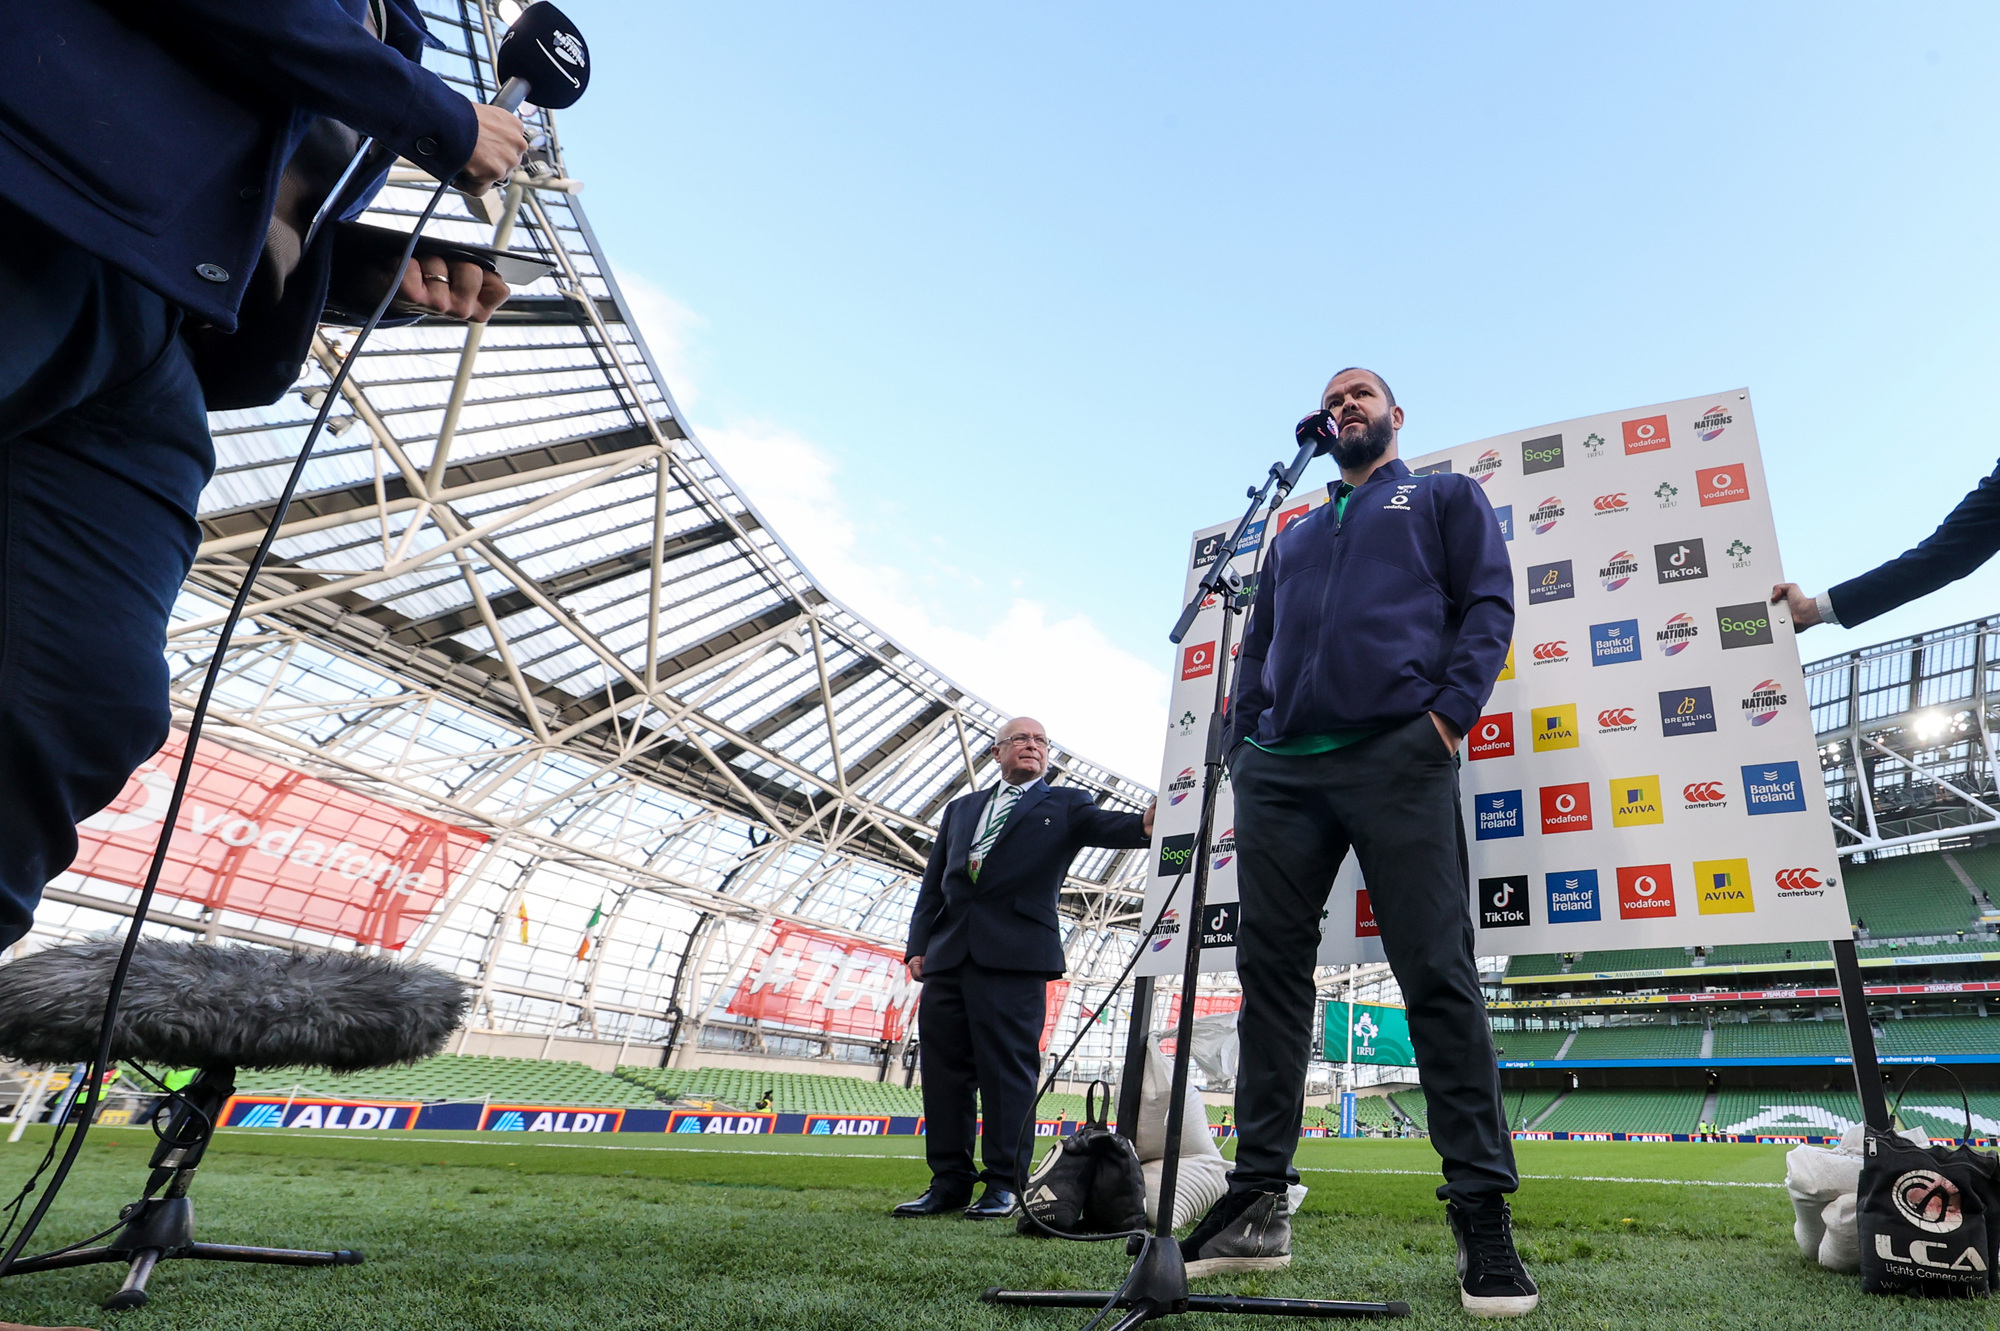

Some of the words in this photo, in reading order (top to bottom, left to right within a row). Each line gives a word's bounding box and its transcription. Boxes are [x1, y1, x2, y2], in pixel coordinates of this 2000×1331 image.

[1693, 415, 1733, 430] NATIONS
[1628, 437, 1667, 449] vodafone
[1524, 447, 1561, 463] Sage
[1587, 451, 1604, 459] IRFU
[1468, 459, 1502, 475] NATIONS
[1703, 487, 1745, 499] vodafone
[1594, 506, 1630, 517] canterbury
[1659, 501, 1678, 510] IRFU
[1529, 507, 1565, 523] NATIONS
[1599, 562, 1639, 578] NATIONS
[1732, 561, 1752, 569] IRFU
[1662, 566, 1702, 579] TikTok
[1530, 582, 1572, 594] BREITLING
[1720, 617, 1768, 636] Sage
[1656, 626, 1698, 641] NATIONS
[1595, 637, 1622, 649] Bank
[1624, 635, 1634, 645] of
[1596, 644, 1634, 657] Ireland
[1533, 656, 1570, 666] canterbury
[1184, 663, 1211, 674] vodafone
[1752, 689, 1777, 698] AUTUMN
[1741, 694, 1788, 709] NATIONS
[1664, 712, 1713, 724] BREITLING
[1538, 730, 1573, 741] AVIVA
[1598, 724, 1638, 734] canterbury
[1471, 740, 1511, 752] vodafone
[1168, 778, 1197, 793] NATIONS
[1750, 782, 1781, 794] Bank
[1782, 780, 1796, 791] of
[1751, 790, 1796, 804] Ireland
[1618, 804, 1656, 815] AVIVA
[1684, 800, 1728, 810] canterbury
[1480, 811, 1505, 821] Bank
[1507, 808, 1518, 818] of
[1545, 813, 1588, 825] vodafone
[1480, 817, 1517, 830] Ireland
[188, 804, 428, 898] vodafone
[1210, 842, 1236, 855] NATION
[1552, 892, 1580, 902] Bank
[1581, 889, 1594, 900] of
[1704, 890, 1745, 901] AVIVA
[1777, 889, 1824, 898] canterbury
[1552, 899, 1593, 912] Ireland
[1624, 898, 1671, 909] vodafone
[1485, 910, 1525, 923] TikTok
[1203, 932, 1234, 944] TikTok
[1946, 954, 1982, 962] STADIUM
[1356, 1046, 1376, 1056] IRFU
[288, 1104, 398, 1130] ALDI
[527, 1111, 608, 1133] ALDI
[703, 1115, 764, 1135] ALDI
[832, 1119, 881, 1136] ALDI
[1035, 1123, 1054, 1137] LDI
[1310, 1128, 1324, 1138] ALDI
[1583, 1134, 1608, 1142] ALDI
[1023, 1184, 1058, 1206] CA
[1875, 1233, 1988, 1272] LCA
[1885, 1262, 1915, 1276] Lights
[1916, 1267, 1957, 1282] Camera
